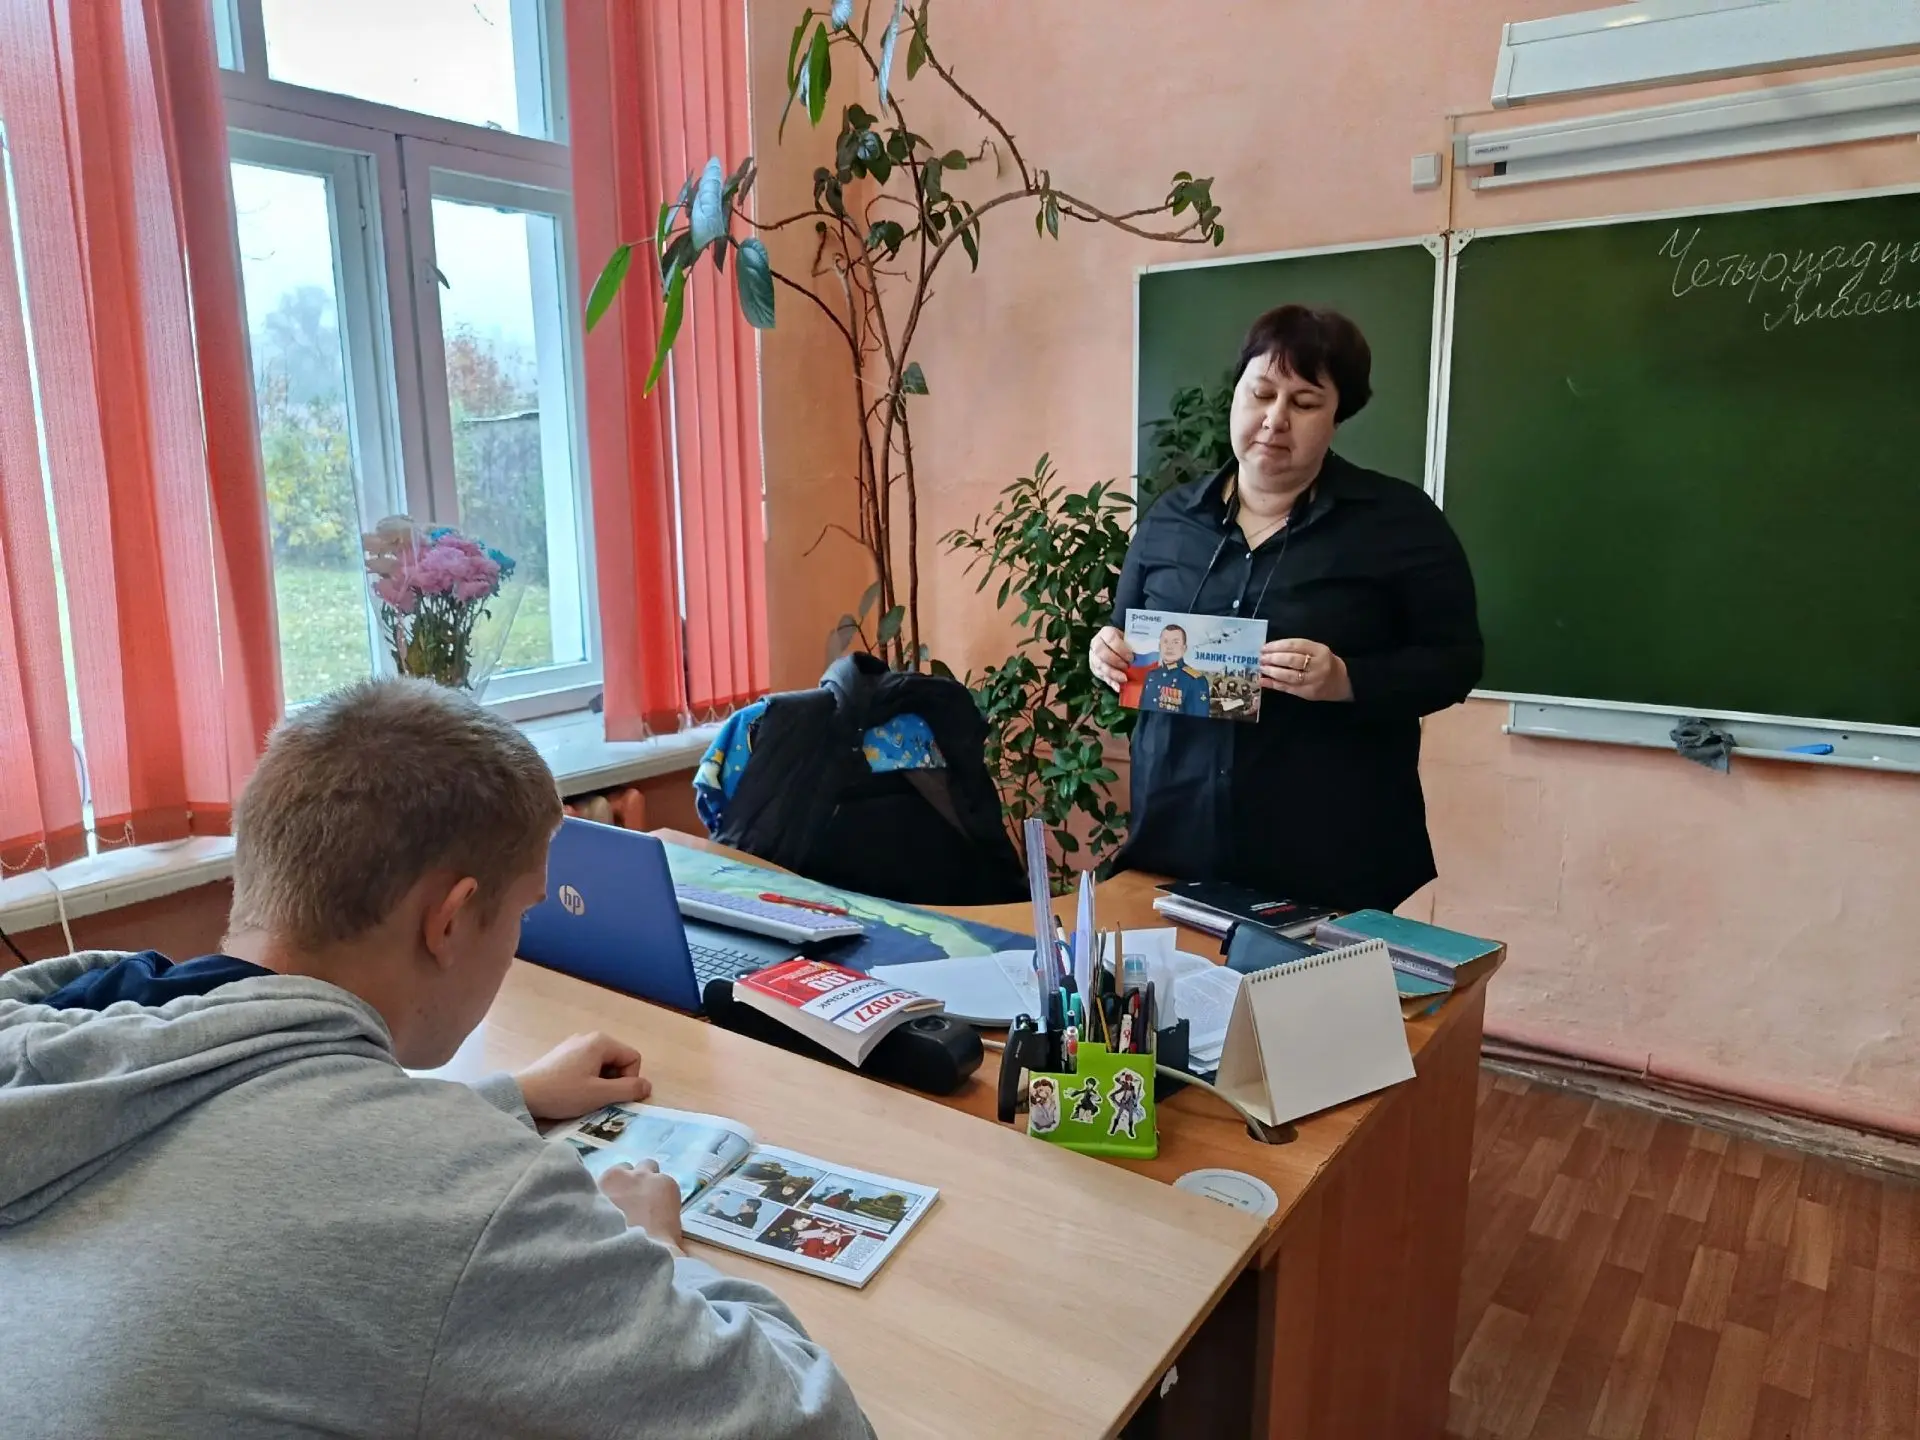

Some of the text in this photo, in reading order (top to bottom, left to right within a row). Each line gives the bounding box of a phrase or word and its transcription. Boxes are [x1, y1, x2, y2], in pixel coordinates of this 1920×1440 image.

[1195, 651, 1227, 663] ЗНАНИЕ
[563, 885, 582, 915] hp
[806, 971, 857, 992] 100
